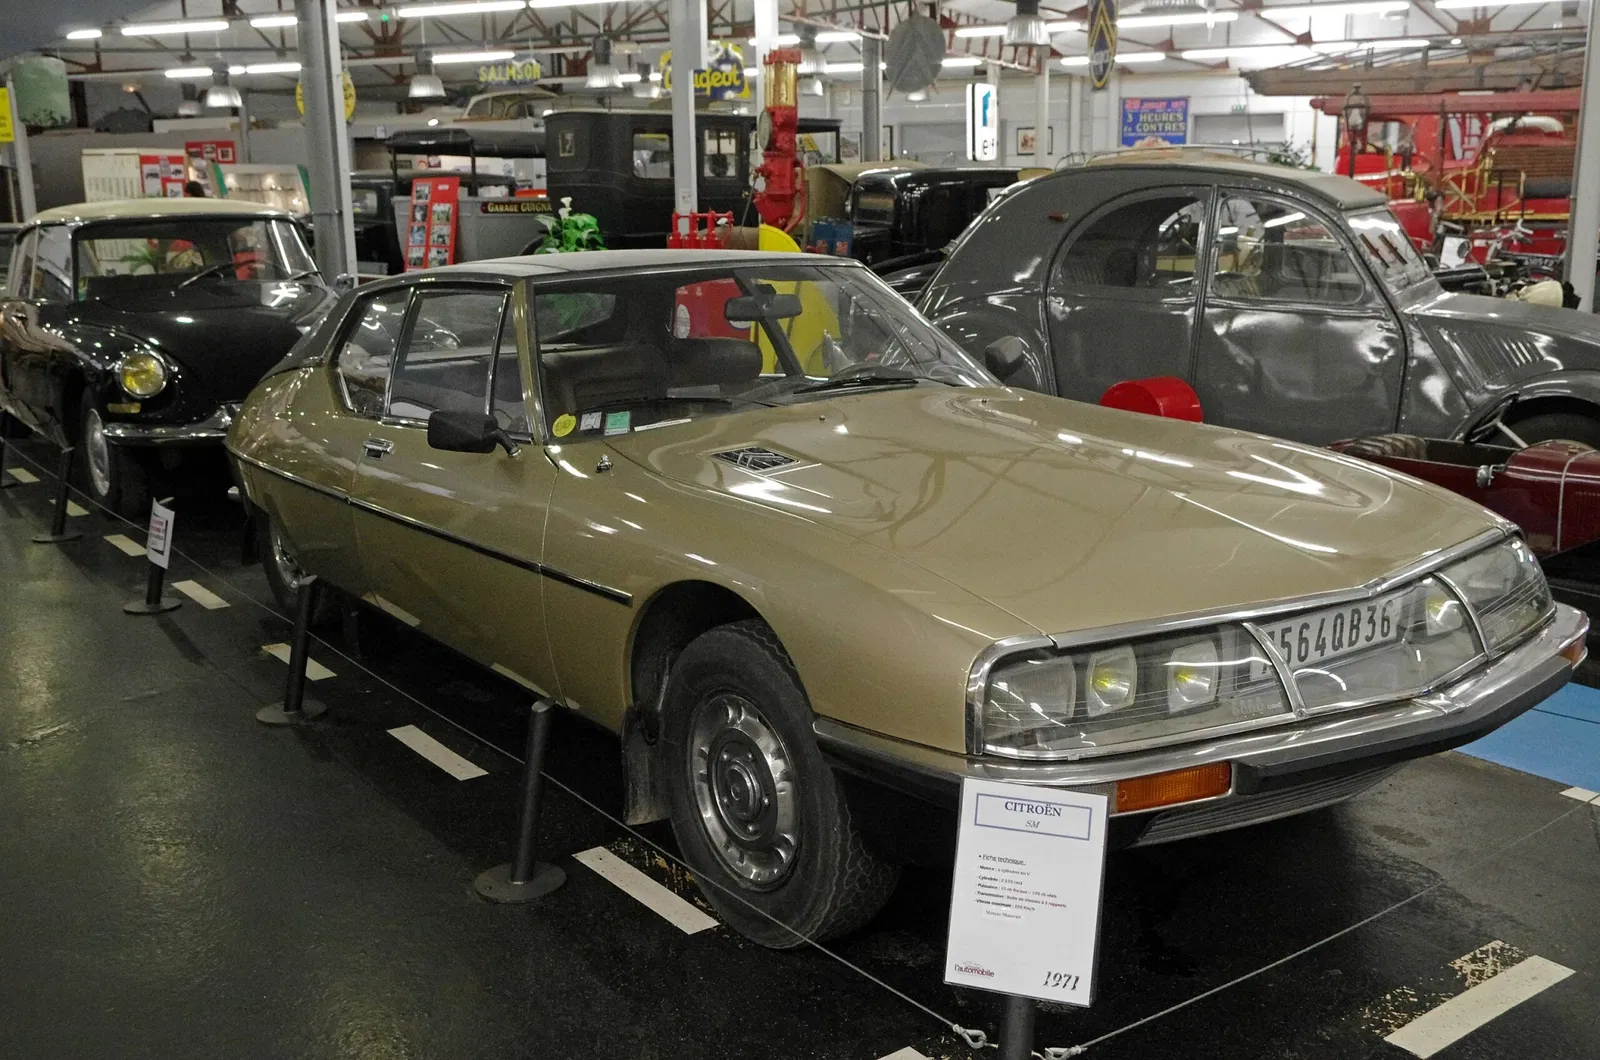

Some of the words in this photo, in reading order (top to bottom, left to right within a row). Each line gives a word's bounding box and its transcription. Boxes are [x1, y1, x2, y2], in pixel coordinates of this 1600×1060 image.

[479, 63, 541, 82] SALMSON
[664, 64, 741, 95] geot
[1139, 112, 1184, 123] HEURES
[1136, 122, 1186, 132] CONTRES
[487, 202, 520, 212] GARAGE
[1004, 801, 1062, 818] CITROËN
[1025, 819, 1041, 829] SM
[982, 854, 997, 862] Fiche
[954, 963, 995, 978] l'automobile
[1043, 971, 1081, 991] 1971
